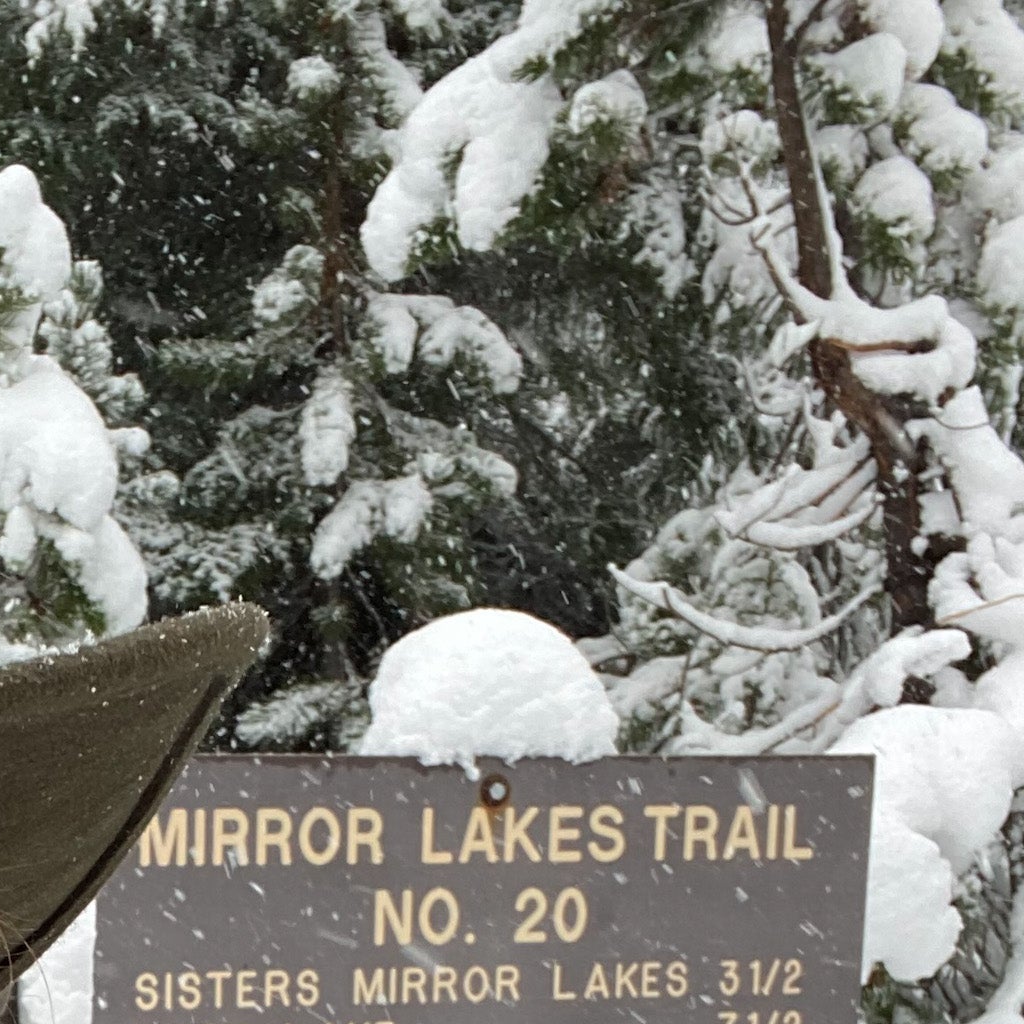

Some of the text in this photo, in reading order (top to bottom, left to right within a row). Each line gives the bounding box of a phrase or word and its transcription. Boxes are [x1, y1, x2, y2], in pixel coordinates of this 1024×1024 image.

[137, 804, 814, 867] MIRROR LAKES TRAIL
[373, 886, 589, 946] NO. 20
[135, 968, 321, 1011] SISTERS
[353, 964, 522, 1003] MIRROR
[553, 961, 689, 1000] LAKES
